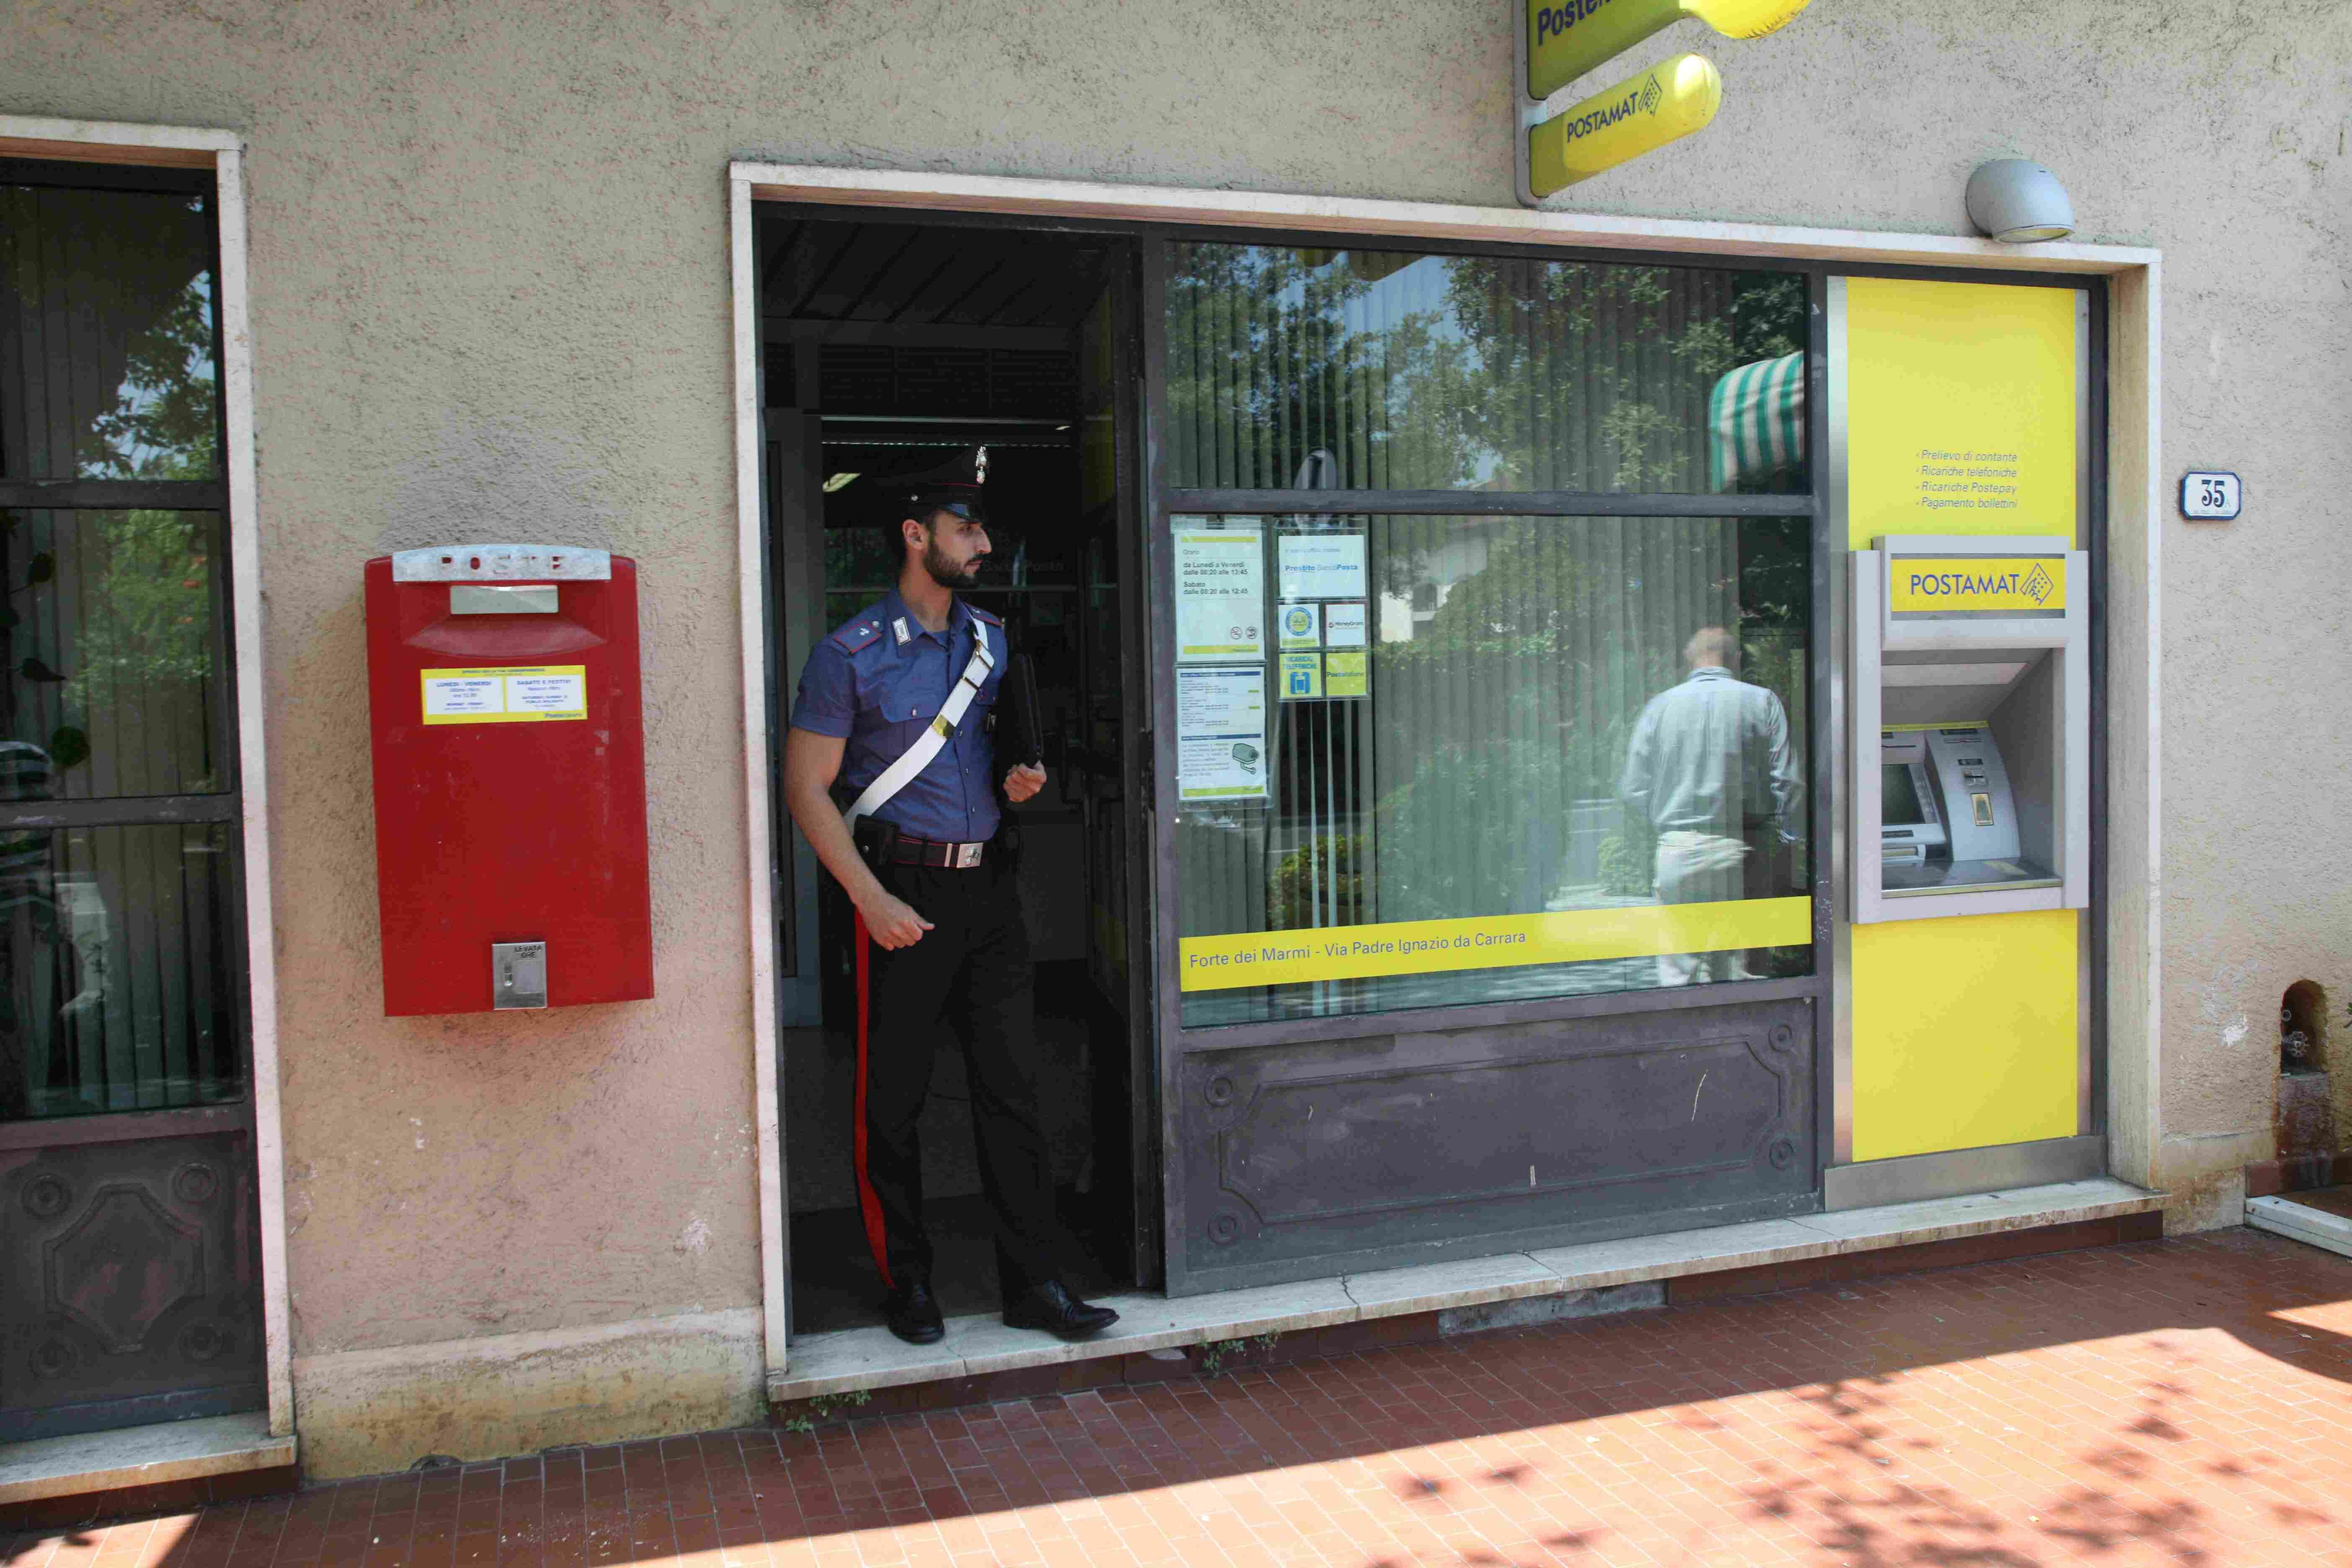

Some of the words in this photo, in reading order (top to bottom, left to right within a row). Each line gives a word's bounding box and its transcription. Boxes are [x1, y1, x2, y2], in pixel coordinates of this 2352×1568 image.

[1567, 91, 1638, 143] POSTAMAT
[1921, 449, 1960, 460] Prelievo
[1964, 450, 1973, 461] di
[1975, 453, 2017, 462] contante
[1921, 465, 1964, 476] Ricariche
[1967, 467, 2017, 477] telefoniche
[1921, 481, 1968, 492] Ricariche
[1971, 482, 2017, 495] Postepay
[2201, 480, 2225, 508] 35
[1922, 497, 1974, 509] Pagamento
[1978, 498, 2017, 508] bollettini
[440, 554, 565, 575] POSTE
[1910, 573, 2019, 596] POSTAMAT
[1190, 954, 1229, 968] Forte
[1234, 949, 1256, 964] dei
[1262, 945, 1310, 962] Marmi
[1324, 943, 1348, 957] Via
[1353, 940, 1394, 955] Padre
[1399, 936, 1449, 954] Ignazio
[1453, 935, 1470, 948] da
[1475, 933, 1526, 946] Carrara
